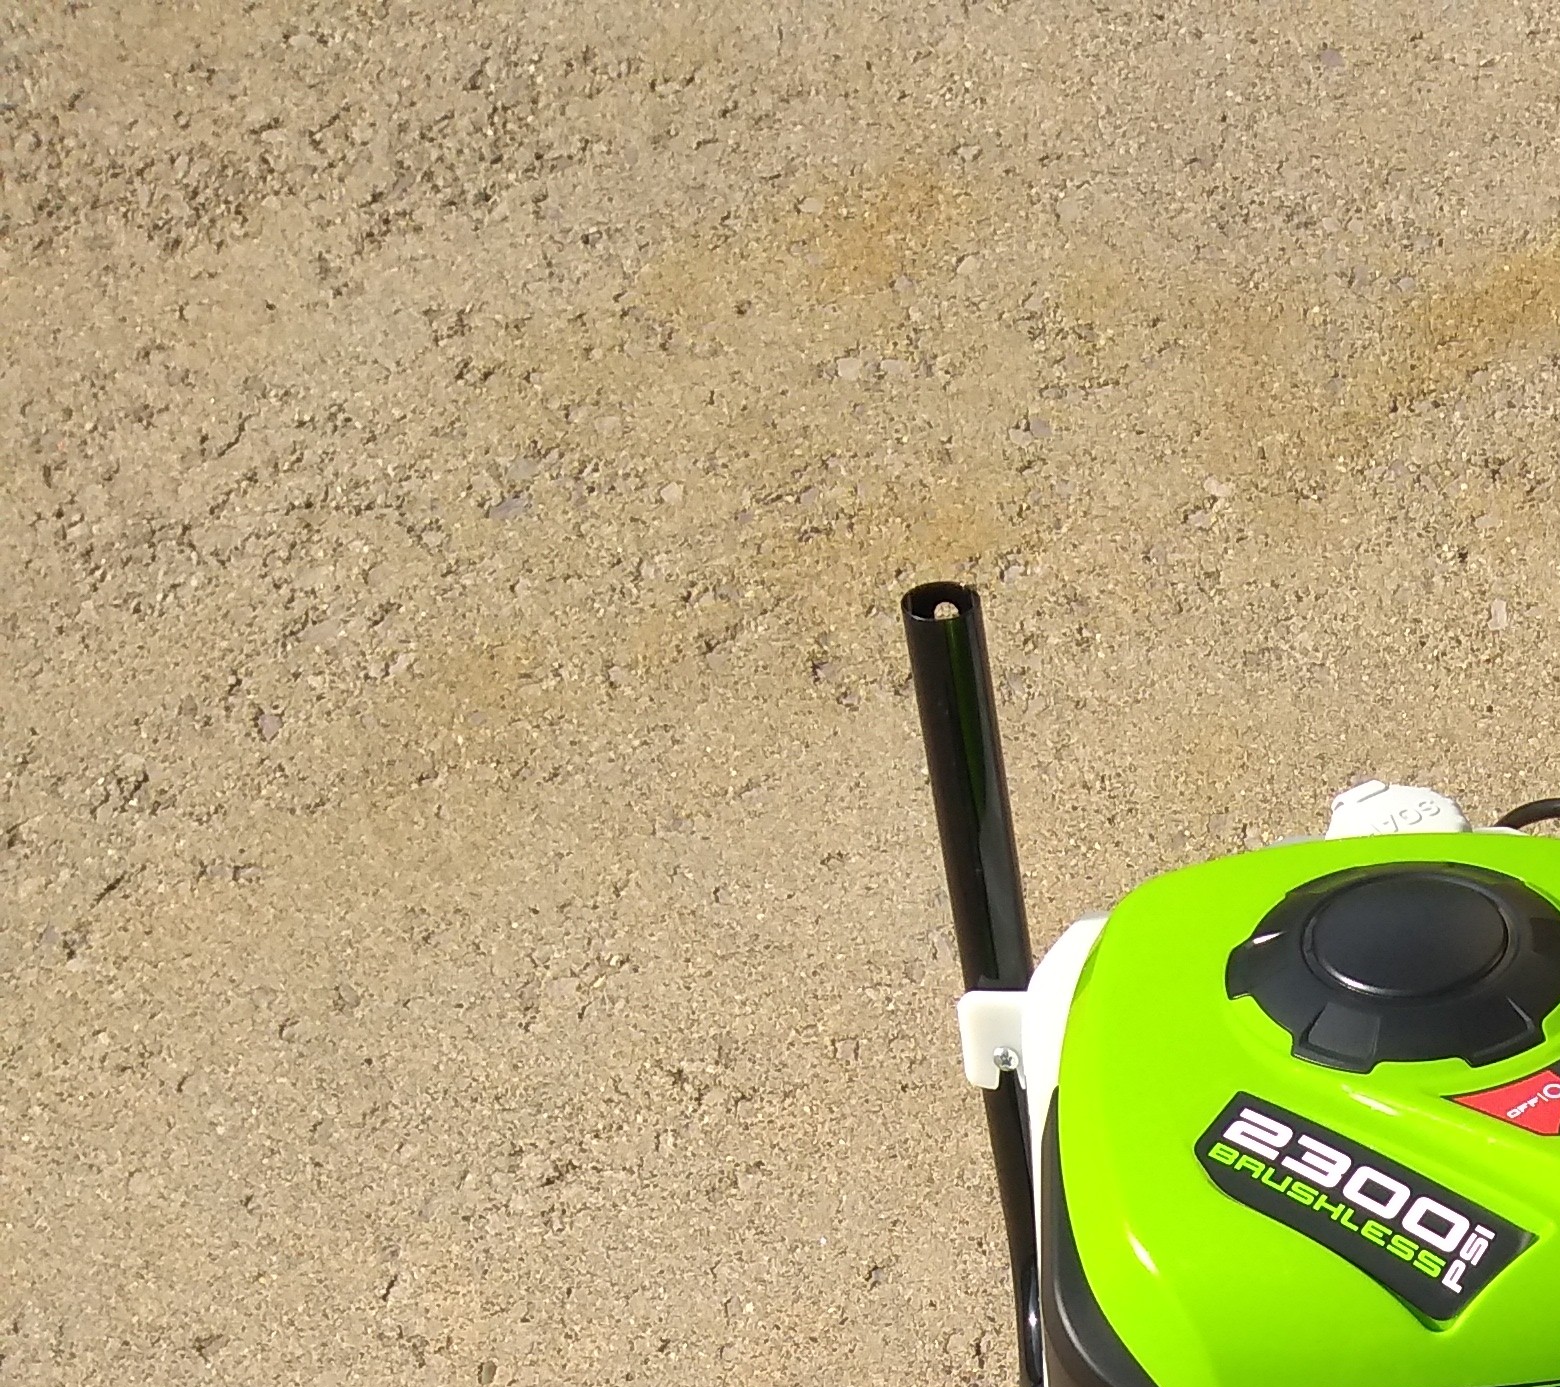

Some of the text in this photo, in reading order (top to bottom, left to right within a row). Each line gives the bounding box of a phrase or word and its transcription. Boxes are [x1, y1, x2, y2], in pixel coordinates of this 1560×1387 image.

[1506, 1096, 1540, 1119] OFF
[1208, 1142, 1446, 1278] BRUSHLESS
[1222, 1108, 1496, 1294] 2300 PSI
